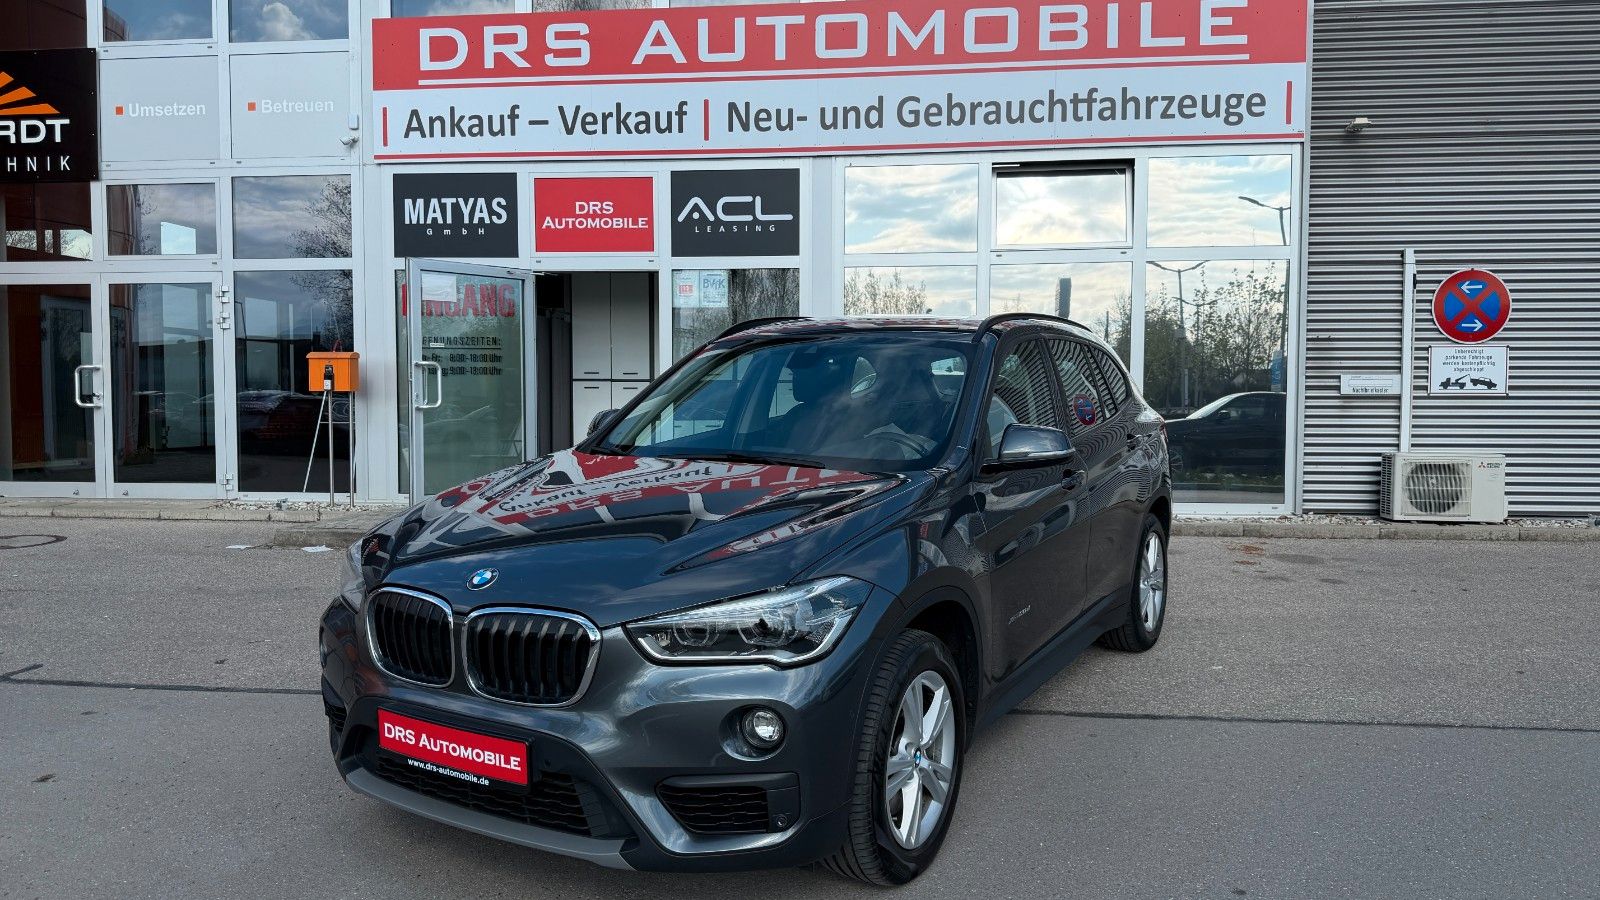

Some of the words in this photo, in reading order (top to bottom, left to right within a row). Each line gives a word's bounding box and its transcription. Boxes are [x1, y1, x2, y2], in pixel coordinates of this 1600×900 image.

[418, 22, 591, 71] DRS
[631, 0, 1249, 65] AUTOMOBILE
[128, 102, 206, 117] Umsetzen
[261, 99, 334, 114] Betreuen
[403, 104, 520, 139] Ankauf
[558, 100, 687, 136] Verkauf
[727, 101, 807, 133] Neu-
[819, 95, 884, 131] und
[896, 87, 1267, 129] Gebrauchtfahrzeuge
[404, 197, 508, 225] MATYAS
[575, 201, 614, 215] DRS
[677, 195, 794, 223] ACL
[426, 227, 485, 236] GmbH
[541, 216, 649, 229] AUTOMOBILE
[694, 224, 776, 233] LEASING
[383, 722, 416, 746] DRS
[418, 733, 522, 771] AUTOMOBILE
[407, 758, 490, 786] www.drs-automobile.de
